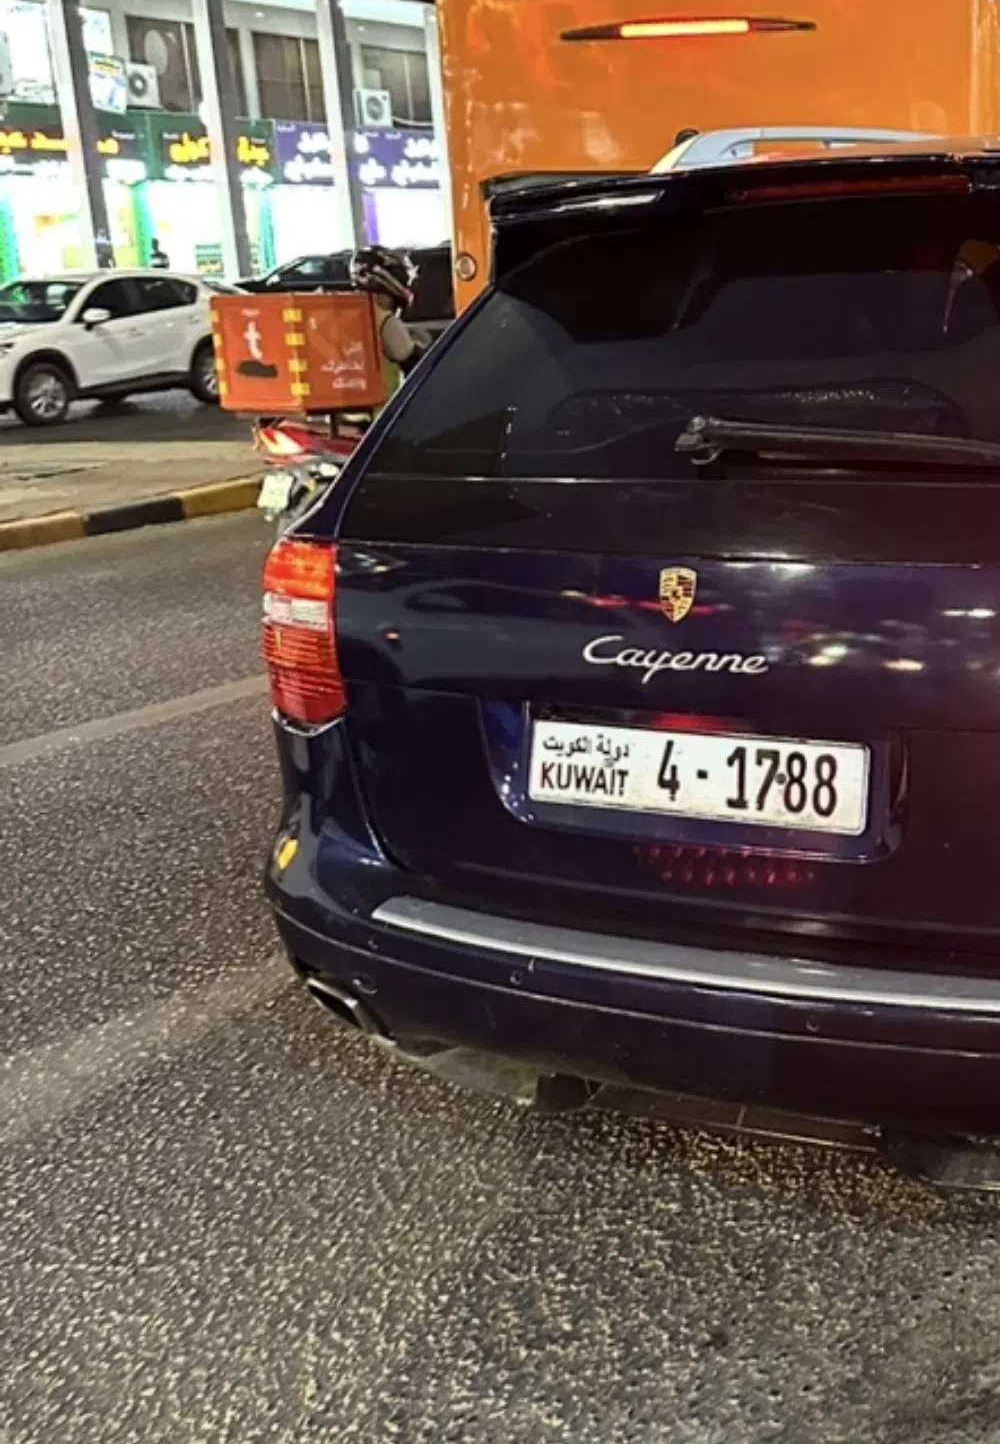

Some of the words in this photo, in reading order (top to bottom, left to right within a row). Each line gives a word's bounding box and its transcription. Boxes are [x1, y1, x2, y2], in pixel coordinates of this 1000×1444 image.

[582, 635, 770, 684] Cayenne
[541, 734, 593, 758] الكويت
[595, 732, 630, 762] دولة
[540, 761, 630, 797] KUWAIT
[656, 739, 681, 801] 4
[726, 745, 838, 818] 1788
